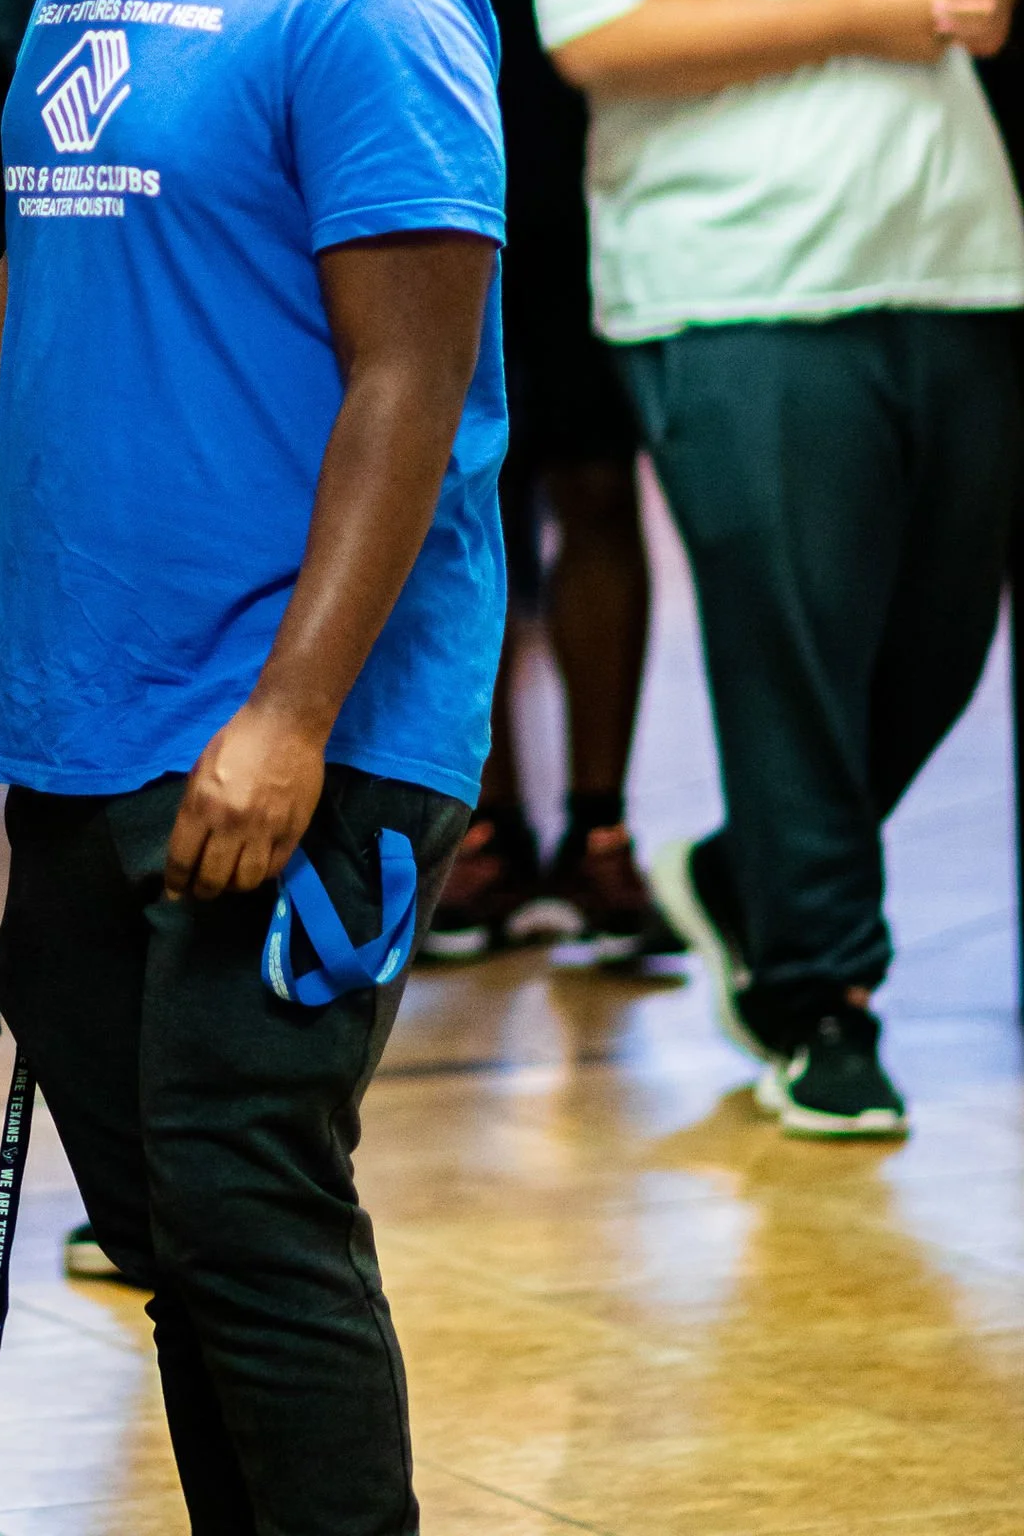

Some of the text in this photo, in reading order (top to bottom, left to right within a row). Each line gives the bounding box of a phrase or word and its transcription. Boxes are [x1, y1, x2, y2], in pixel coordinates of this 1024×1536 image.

[121, 0, 170, 25] START
[4, 166, 161, 196] OYS & GIRLS CLUBS
[13, 1068, 29, 1092] ARE
[5, 1097, 25, 1143] TEXANS
[0, 1168, 14, 1188] WE
